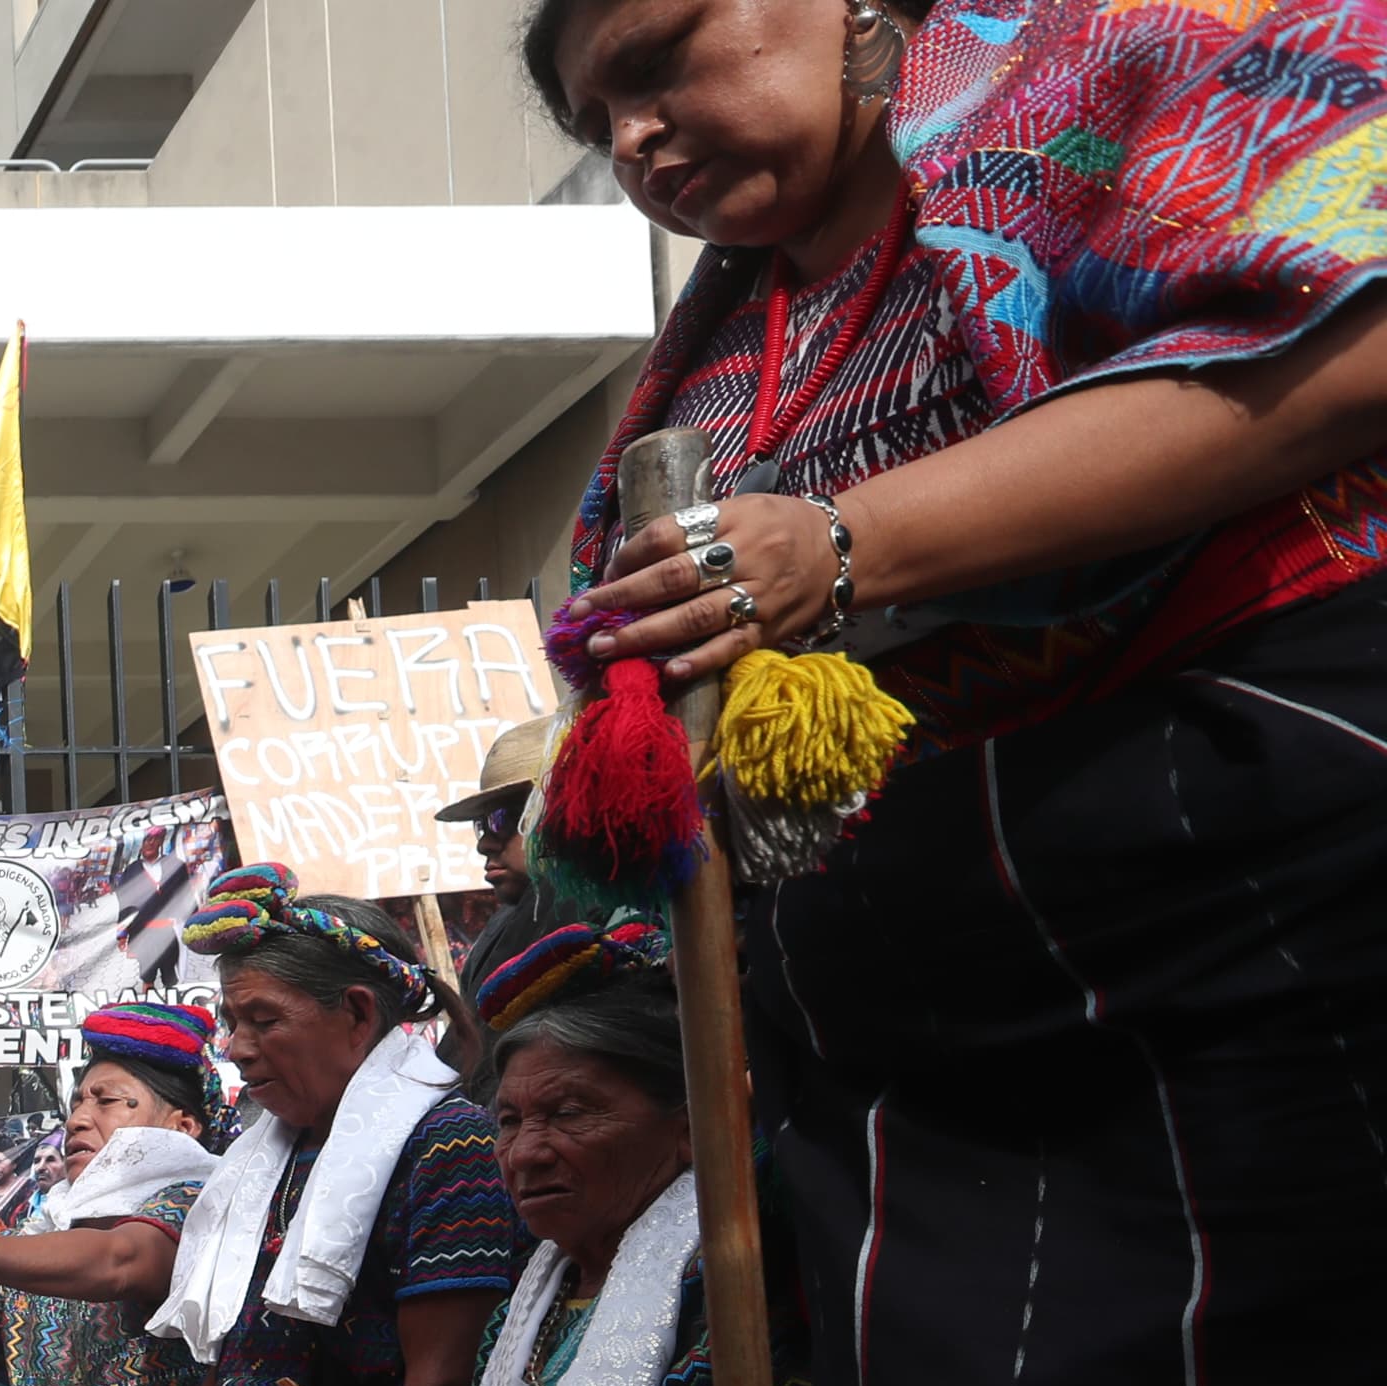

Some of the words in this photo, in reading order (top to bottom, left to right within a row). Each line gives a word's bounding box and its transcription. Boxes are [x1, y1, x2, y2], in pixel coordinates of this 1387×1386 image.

[195, 623, 543, 732] FUERA
[219, 718, 515, 786] CORRUPT
[39, 794, 231, 853] INDÍGENA
[34, 893, 53, 937] ALIADAS
